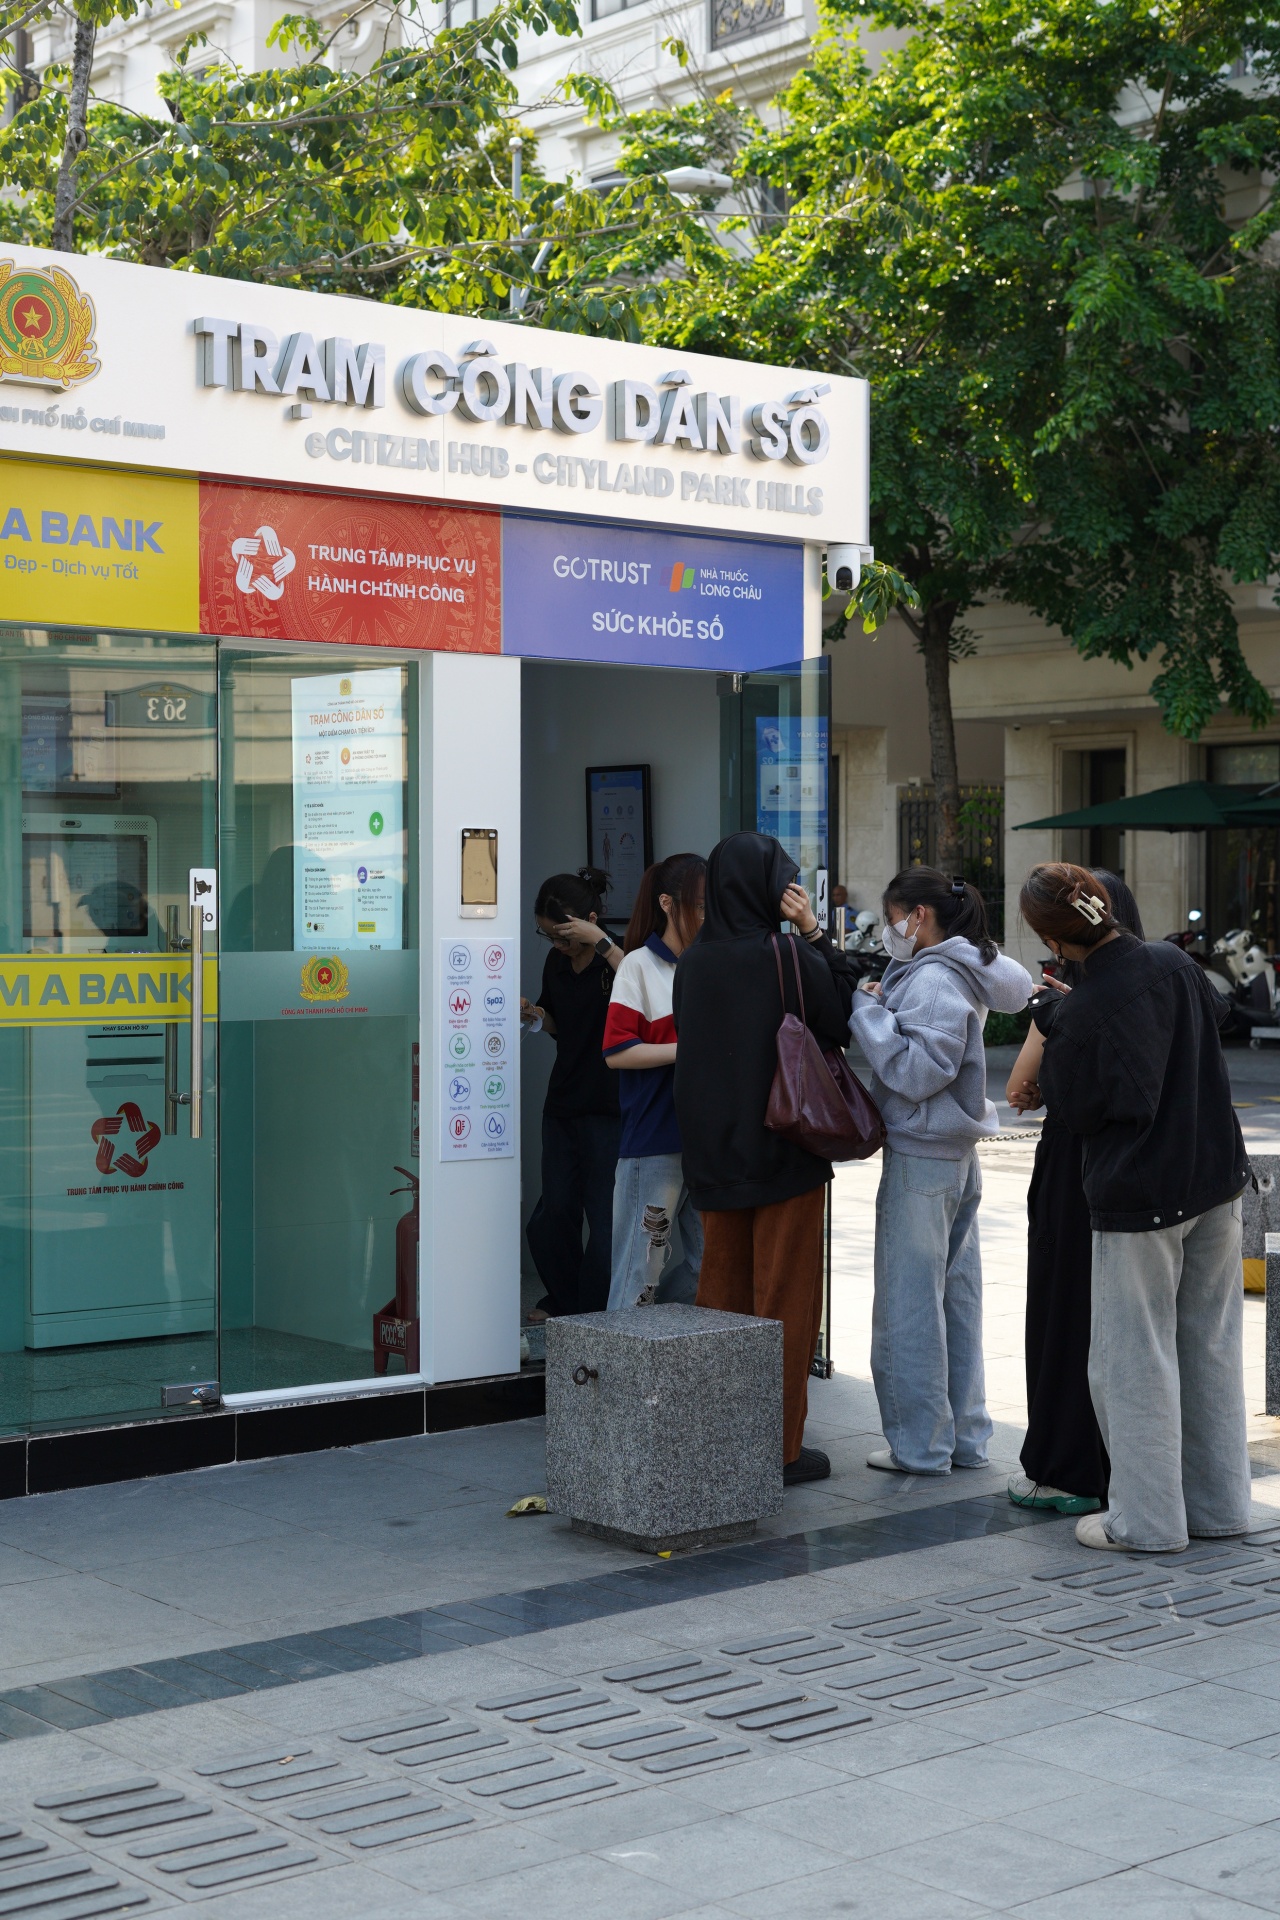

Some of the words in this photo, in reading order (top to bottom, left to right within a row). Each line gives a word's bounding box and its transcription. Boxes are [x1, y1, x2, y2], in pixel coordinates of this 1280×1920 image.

[194, 316, 386, 420] TRẠM
[402, 339, 603, 436] CÔNG
[614, 369, 741, 456] DÂN
[749, 382, 832, 466] SỐ
[22, 404, 59, 428] PHỐ
[61, 406, 88, 430] HỒ
[90, 415, 122, 434] CHÍ
[123, 421, 166, 440] MINH
[304, 427, 440, 472] eCITIZEN
[448, 440, 510, 478] HUB
[515, 462, 528, 474] -
[533, 452, 675, 498] CITYLAND
[681, 470, 751, 508] PARK
[756, 479, 824, 516] HILLS
[0, 507, 32, 542] A
[41, 510, 166, 554] BANK
[4, 554, 38, 574] Đẹp
[52, 558, 87, 576] Dịch
[91, 565, 110, 580] vụ
[112, 562, 140, 580] Tốt
[308, 544, 366, 564] TRUNG
[368, 548, 404, 568] TÂM
[406, 554, 450, 574] PHỤC
[454, 558, 476, 576] VỤ
[553, 555, 652, 585] GOTRUST
[308, 574, 357, 594] HÀNH
[360, 579, 416, 598] CHÍNH
[418, 584, 465, 603] CÔNG
[700, 568, 718, 580] NHÀ
[720, 568, 749, 582] THUỐC
[700, 584, 730, 598] LONG
[733, 585, 762, 600] CHÂU
[592, 608, 634, 634] SỨC
[638, 611, 694, 638] KHỎE
[697, 614, 724, 640] SỐ
[310, 714, 330, 727] TRẠM
[331, 709, 354, 723] CÔNG
[356, 708, 372, 721] DÂN
[38, 974, 70, 1006] A
[79, 973, 192, 1005] BANK
[487, 997, 503, 1006] SpO2
[67, 1187, 87, 1196] TRUNG
[89, 1186, 102, 1194] TÂM
[103, 1186, 120, 1194] PHỤC
[121, 1185, 129, 1194] VỤ
[130, 1183, 147, 1192] HÀNH
[148, 1182, 166, 1191] CHÍNH
[168, 1181, 184, 1190] CÔNG
[382, 1324, 396, 1345] PCCC
